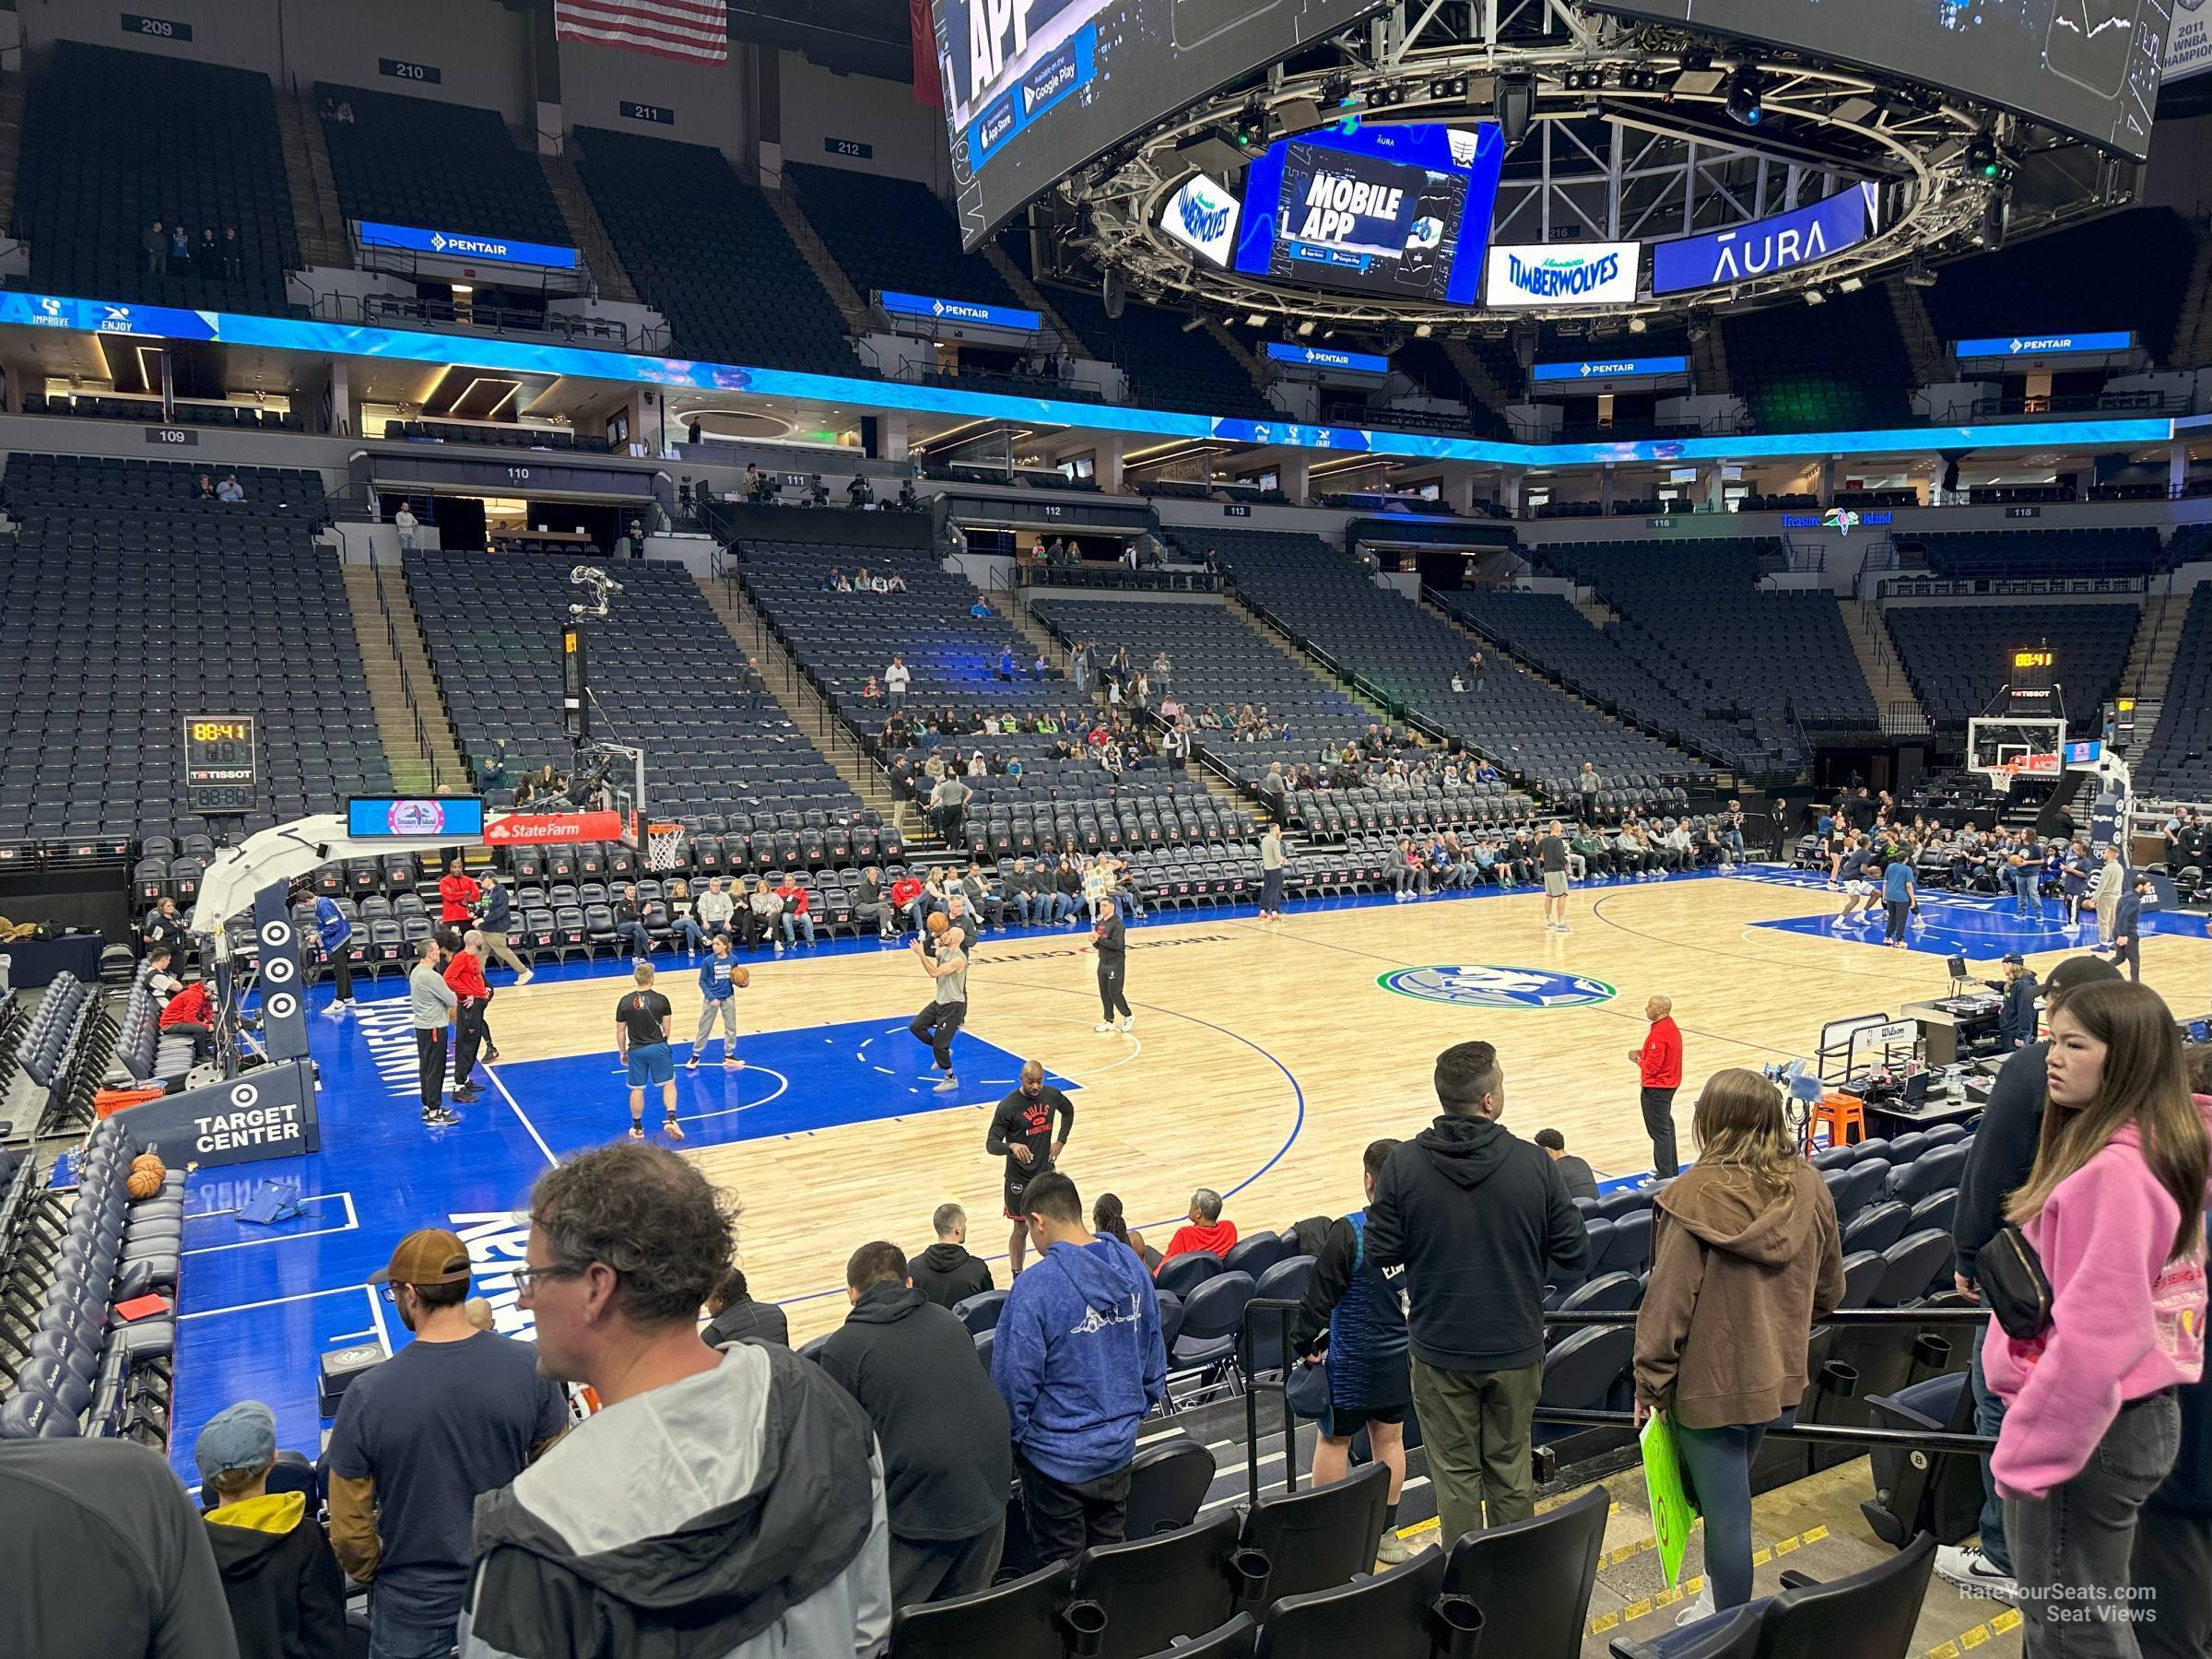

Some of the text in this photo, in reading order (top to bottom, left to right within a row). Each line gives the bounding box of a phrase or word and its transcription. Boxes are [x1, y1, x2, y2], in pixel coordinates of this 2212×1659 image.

[141, 18, 172, 37] 209
[2178, 20, 2204, 37] 2011
[2173, 34, 2207, 52] WNBA
[2163, 44, 2212, 68] HAMPION
[395, 63, 424, 79] 210
[1035, 63, 1076, 100] Google Play
[634, 105, 657, 121] 211
[988, 125, 998, 142] App
[997, 114, 1011, 133] Store
[838, 141, 859, 156] 212
[1305, 174, 1404, 221] MOBILE
[1300, 206, 1356, 243] APP
[1548, 228, 1569, 238] 216
[448, 239, 507, 255] PENTAIR
[1509, 252, 1618, 298] TIMBERWOLVES
[946, 305, 989, 319] PENTAIR
[32, 314, 70, 327] IMPROVE
[101, 320, 133, 333] ENJOY
[2023, 338, 2072, 349] PENTAIR
[1315, 353, 1349, 365] PENTAIR
[1592, 363, 1634, 373] PENTAIR
[159, 430, 185, 442] 109
[507, 467, 529, 479] 110
[787, 475, 804, 486] 111
[1045, 506, 1061, 516] 112
[1230, 507, 1245, 516] 113
[2014, 508, 2031, 517] 118
[1653, 518, 1670, 528] 116
[1783, 511, 1892, 527] Treasure Island
[206, 770, 253, 779] TISSOT
[968, 950, 1082, 966] CENTE
[1881, 1026, 1904, 1038] Wilson
[1023, 1102, 1050, 1121] BULLS
[194, 1104, 298, 1135] TARGET
[196, 1122, 300, 1153] CENTER
[1915, 1454, 1924, 1465] B
